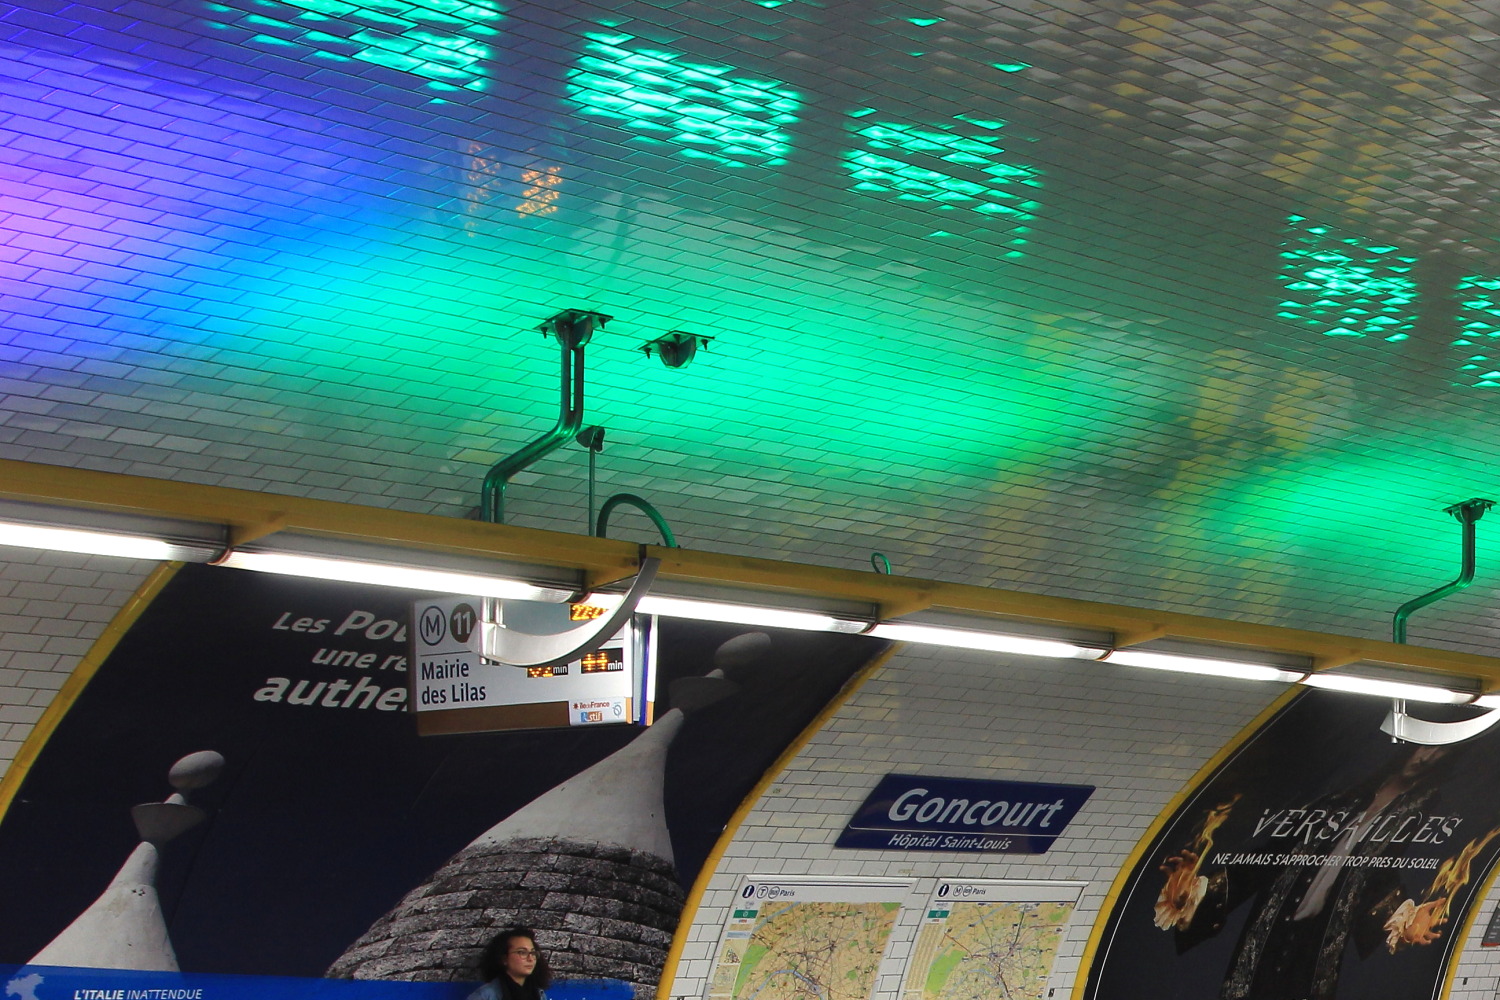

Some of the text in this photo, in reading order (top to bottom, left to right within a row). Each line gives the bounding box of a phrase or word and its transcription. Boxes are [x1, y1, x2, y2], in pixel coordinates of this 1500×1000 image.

[272, 612, 331, 633] Les
[453, 611, 471, 635] 11
[312, 648, 377, 668] une
[607, 660, 623, 670] min
[420, 661, 469, 680] Mairie
[421, 683, 486, 705] des Lilas
[888, 788, 1064, 828] Goncourt
[1252, 808, 1464, 850] VERSAILLES
[888, 834, 1012, 850] Hôpital Saint-Louis
[1212, 853, 1229, 865] NE
[1229, 853, 1272, 866] JAMAIS
[1272, 853, 1342, 867] S'APPROCHER
[1342, 855, 1370, 868] TROP
[1392, 857, 1409, 868] DU
[1407, 857, 1441, 869] SOLEIL
[74, 989, 203, 1000] L'ITALIE INATTENDUE
